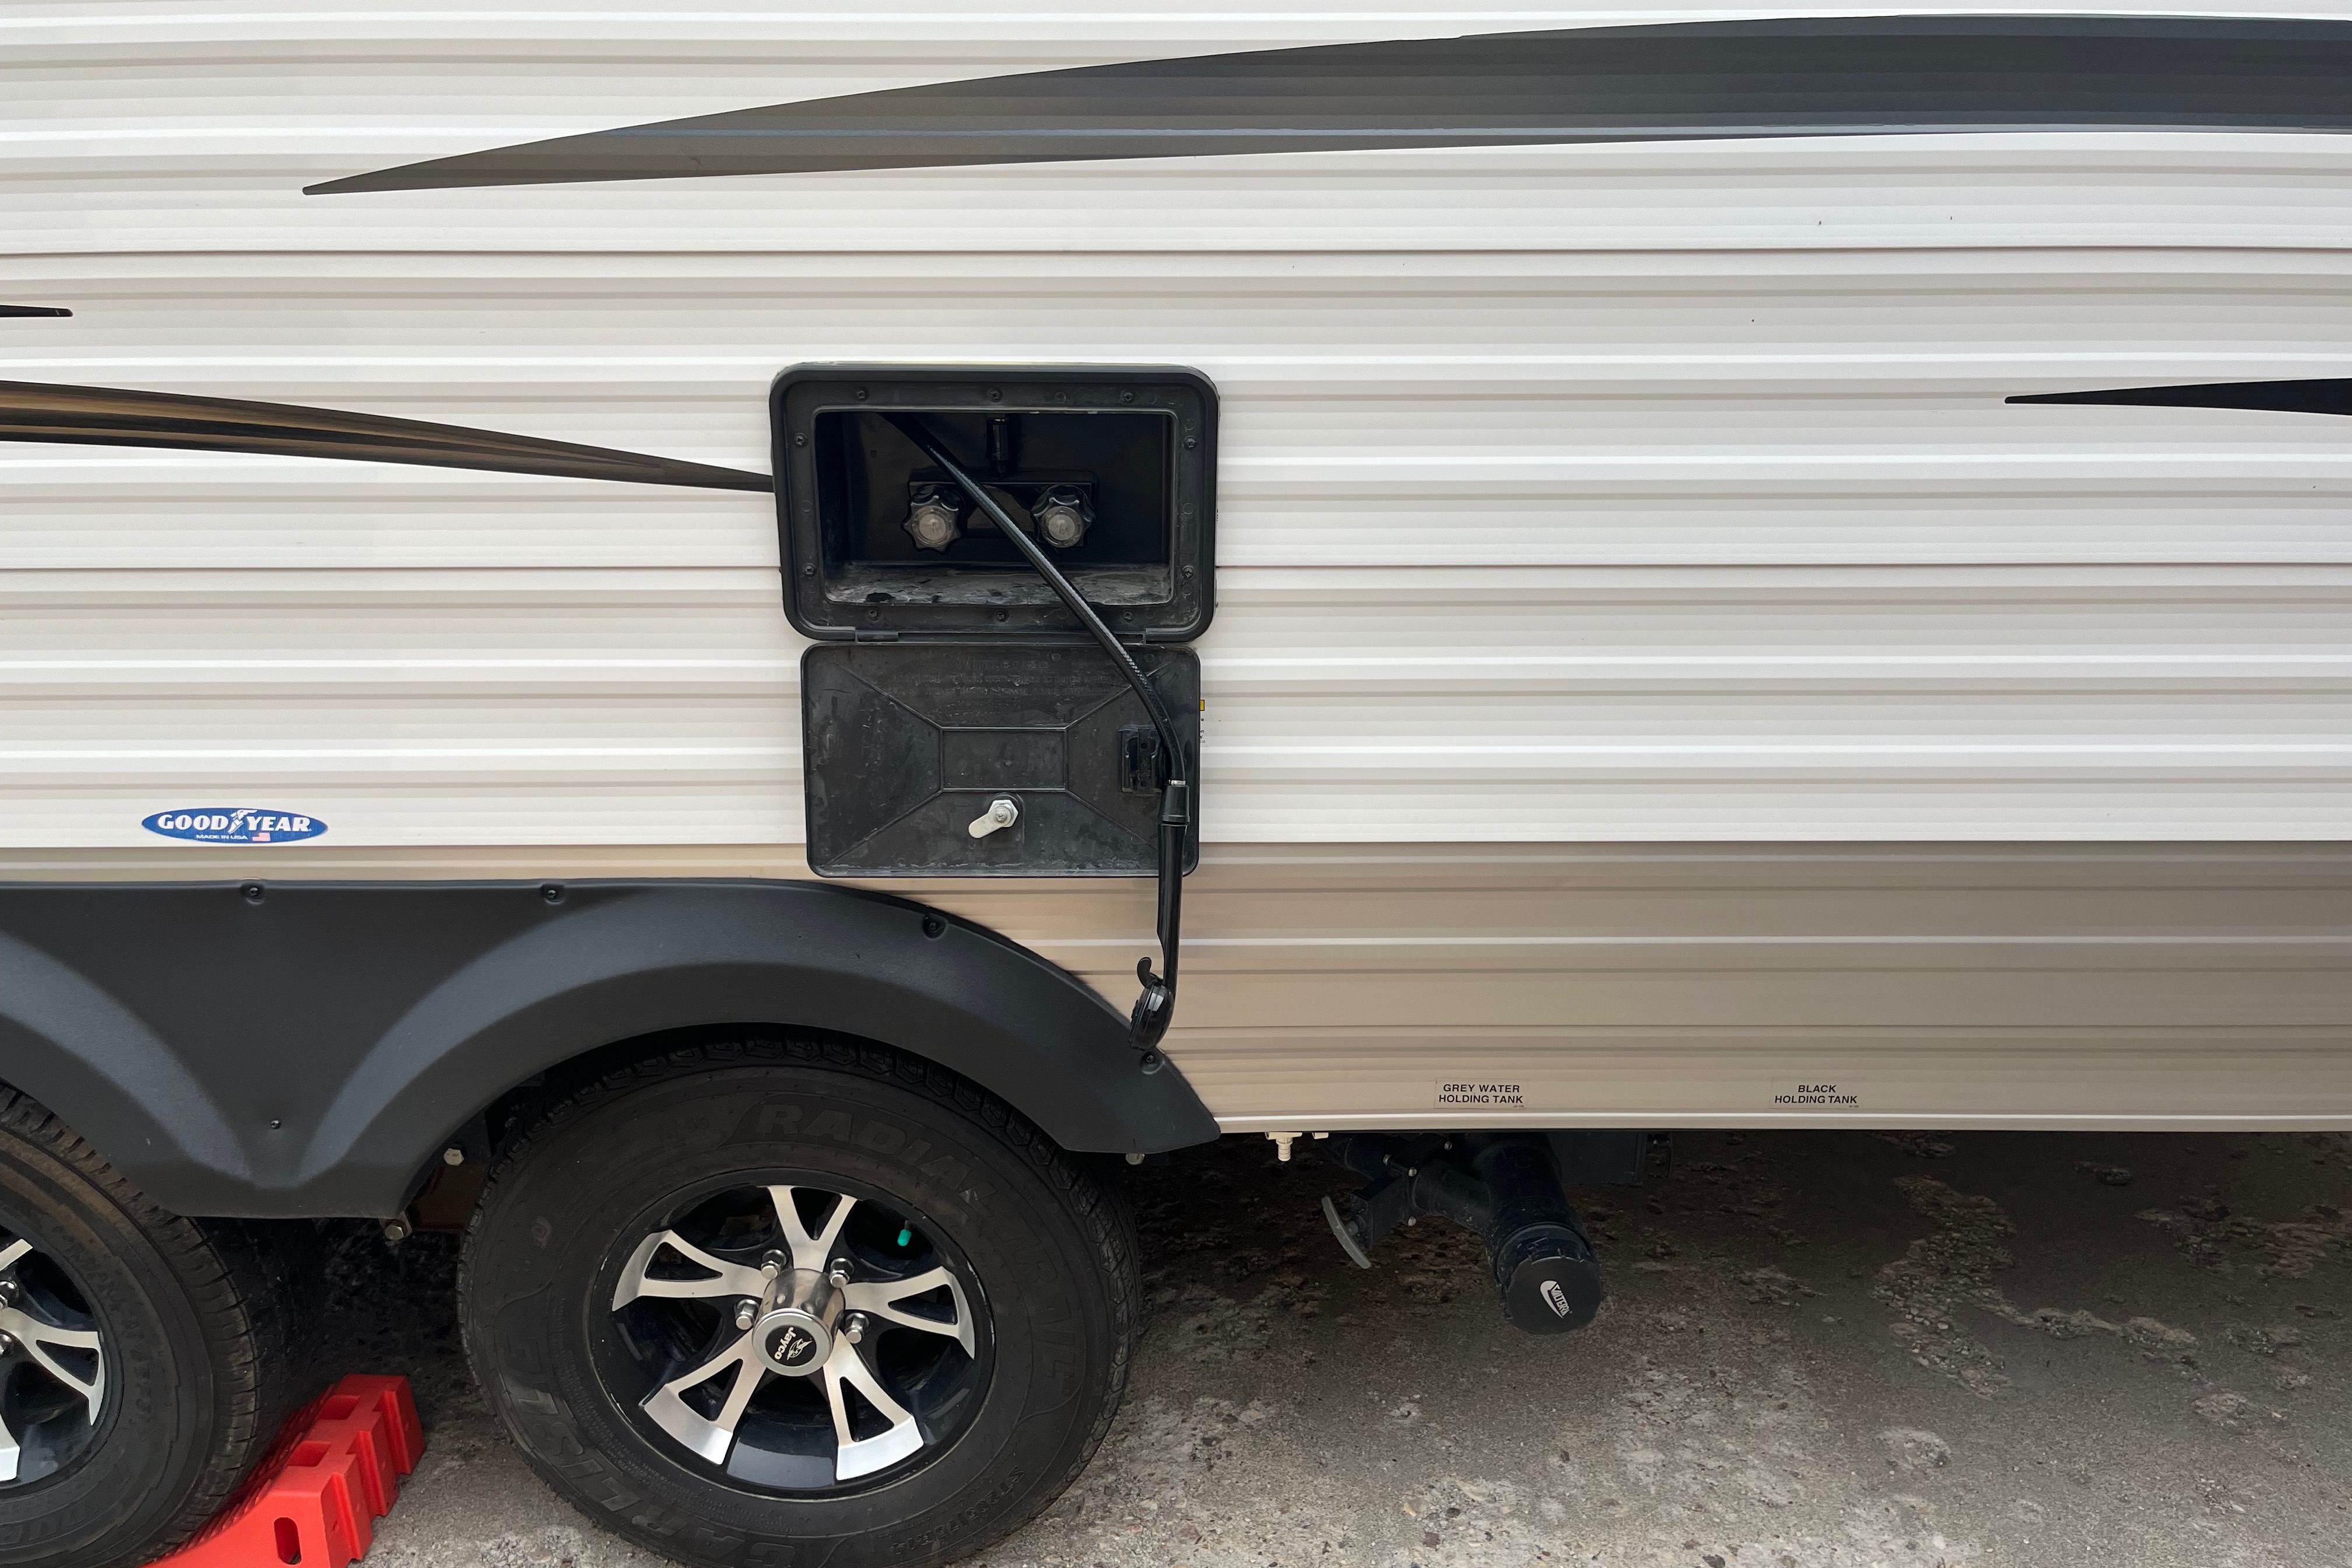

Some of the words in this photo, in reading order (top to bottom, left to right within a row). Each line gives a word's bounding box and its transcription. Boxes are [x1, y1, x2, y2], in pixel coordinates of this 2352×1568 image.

[1443, 1084, 1475, 1093] GREY
[1479, 1084, 1520, 1093] WATER
[1798, 1084, 1837, 1093] BLACK
[1438, 1094, 1489, 1104] HOLDING
[1493, 1095, 1523, 1104] TANK
[1774, 1095, 1825, 1104] HOLDING
[1828, 1095, 1857, 1104] TANK
[755, 1103, 999, 1220] RADIAL
[774, 1326, 796, 1360] Jayco
